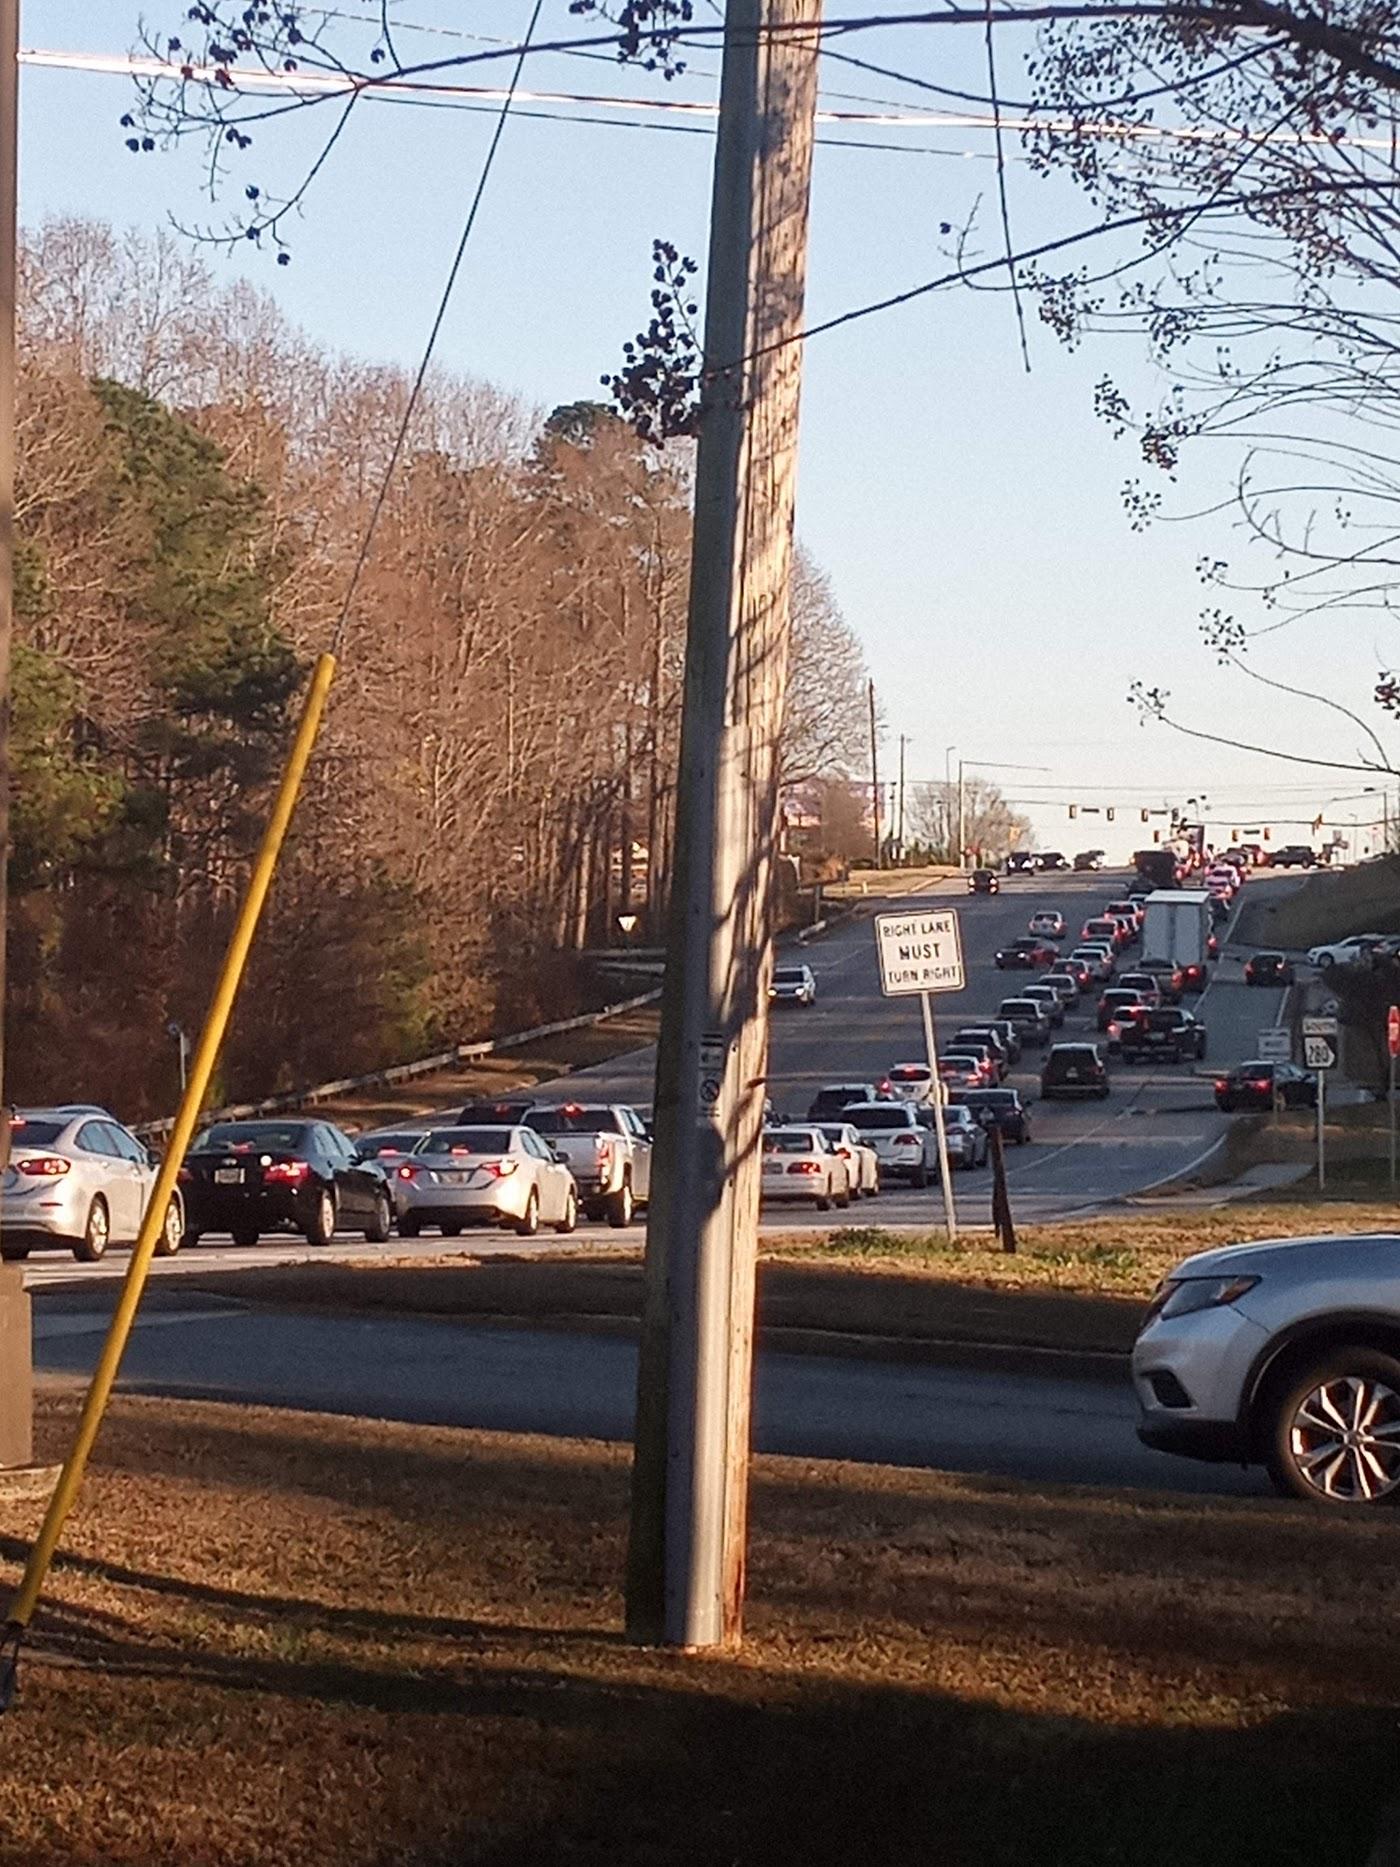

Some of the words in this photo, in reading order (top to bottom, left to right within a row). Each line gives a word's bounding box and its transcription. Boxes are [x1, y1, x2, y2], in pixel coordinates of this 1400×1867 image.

[883, 923, 916, 937] RIGHT
[921, 920, 951, 934] LANE
[898, 943, 940, 960] MUST
[888, 969, 918, 984] TURN
[923, 966, 957, 980] RIGHT
